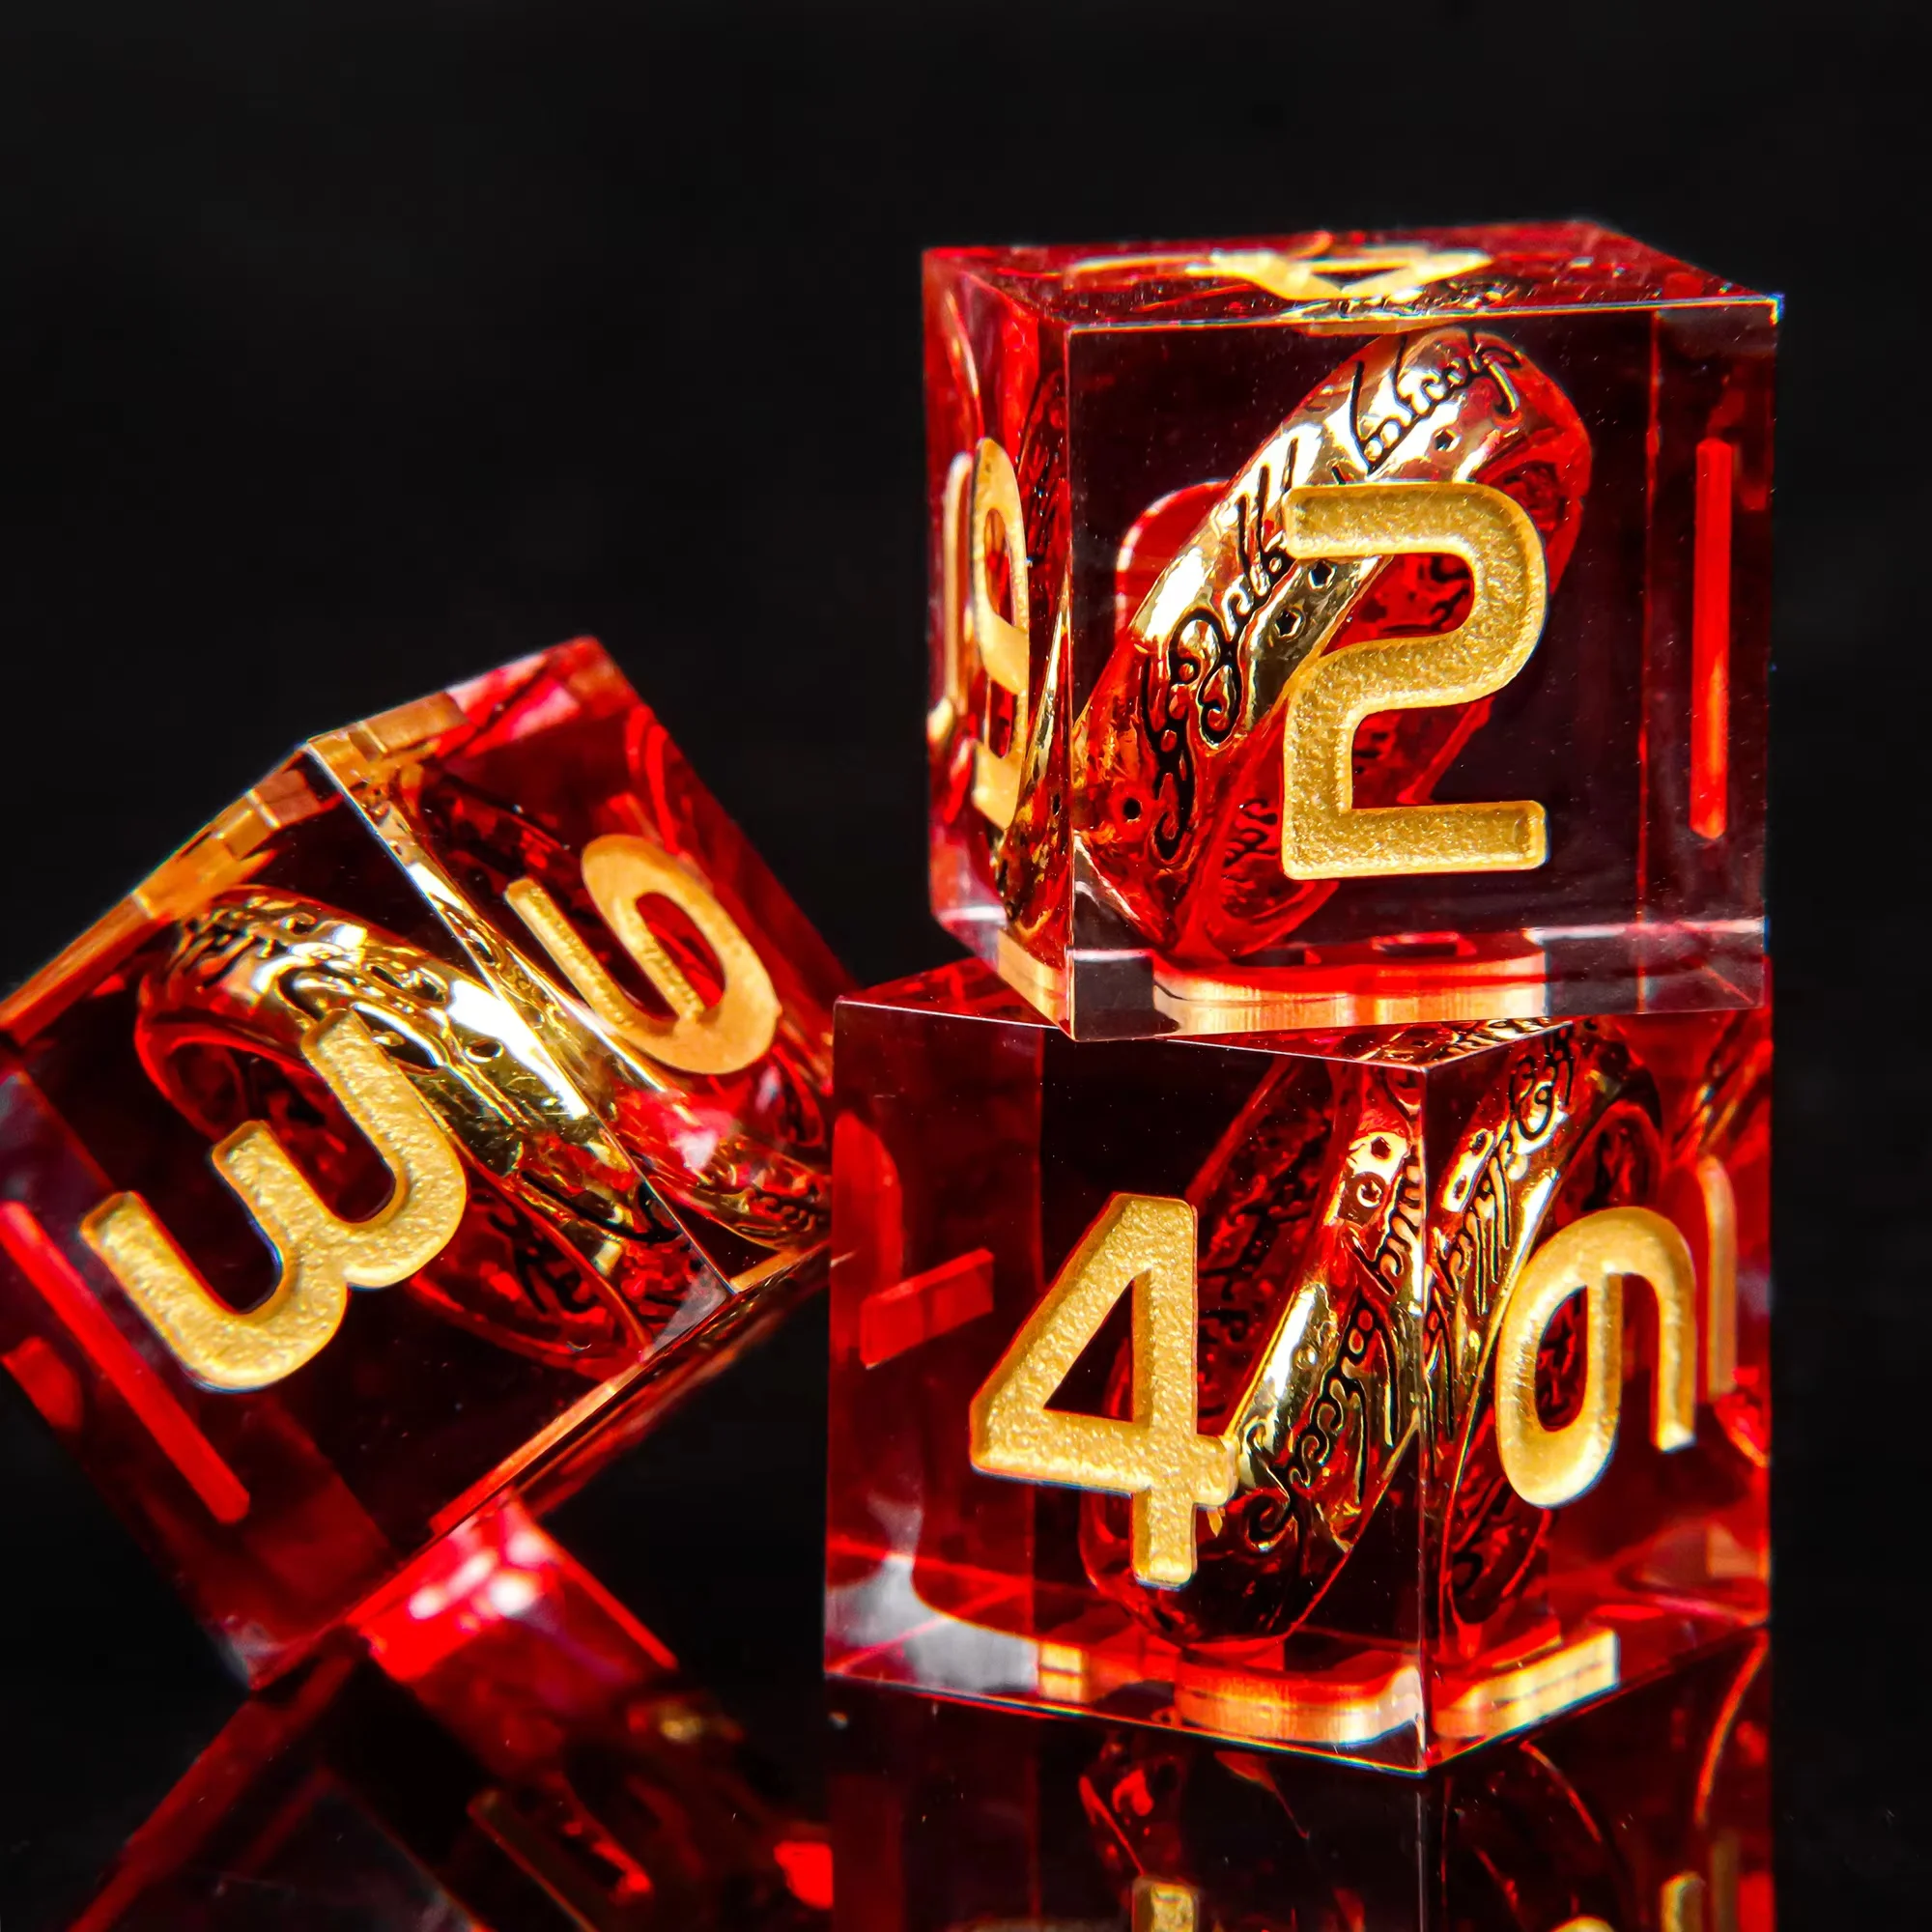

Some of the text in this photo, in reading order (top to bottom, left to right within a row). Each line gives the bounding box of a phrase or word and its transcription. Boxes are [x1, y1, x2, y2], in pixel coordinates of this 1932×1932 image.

[1282, 480, 1547, 881] 2
[80, 1008, 468, 1392] 3
[969, 1193, 1236, 1587] 4
